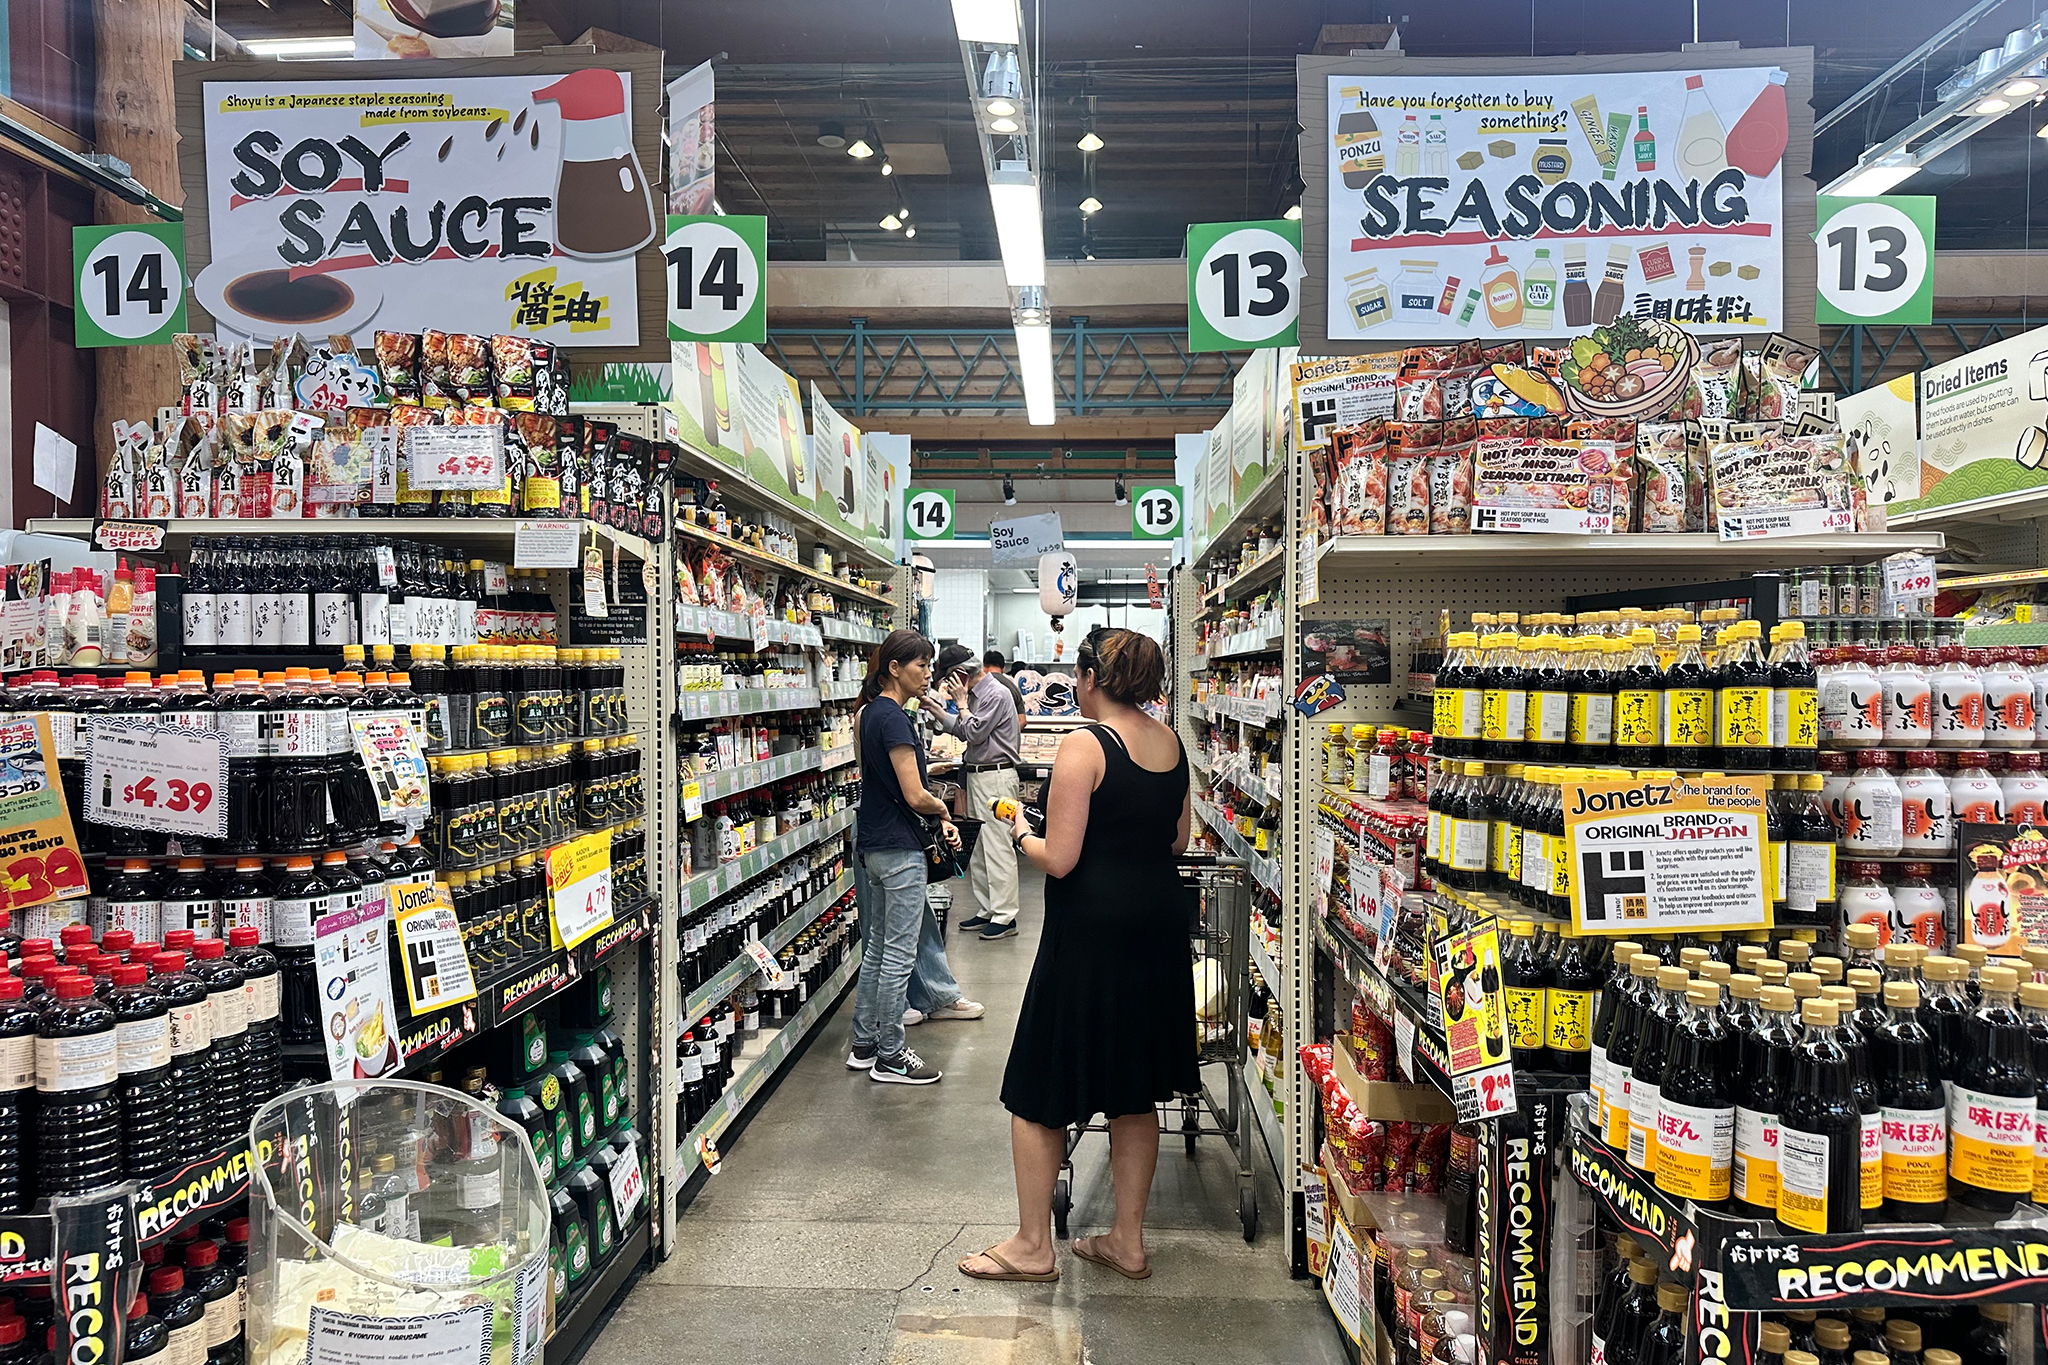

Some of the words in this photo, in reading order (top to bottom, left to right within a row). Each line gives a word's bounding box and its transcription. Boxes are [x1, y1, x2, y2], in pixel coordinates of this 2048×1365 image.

[227, 95, 261, 107] Shoyu
[265, 95, 275, 106] is
[278, 97, 286, 106] a
[289, 94, 345, 108] Japanese
[348, 93, 385, 106] staple
[388, 93, 445, 107] seasoning
[1359, 91, 1394, 108] Have
[1402, 96, 1425, 110] you
[1430, 91, 1500, 112] forgotten
[1505, 92, 1518, 107] to
[1524, 89, 1553, 109] buy
[365, 108, 397, 119] made
[400, 107, 428, 118] from
[432, 106, 491, 120] soybeans.
[1481, 110, 1568, 133] something?
[1580, 108, 1605, 145] GINGER
[1339, 140, 1382, 160] PONZU
[1638, 151, 1653, 159] sauce
[1639, 143, 1650, 152] HOT
[230, 131, 411, 198] SOY
[1538, 160, 1565, 169] MUSTARD
[1361, 169, 1750, 240] SEASONING
[277, 196, 553, 266] SAUCE
[1646, 257, 1665, 267] CURRY
[1825, 225, 1908, 293] 13
[666, 246, 743, 310] 14
[1566, 271, 1586, 279] SAUCE
[1604, 270, 1624, 280] SAUCE
[92, 252, 167, 316] 14
[1209, 250, 1289, 318] 13
[1529, 284, 1549, 293] VINE
[511, 281, 600, 325] 醤油
[1408, 299, 1428, 307] SOLT
[1492, 291, 1513, 302] honey
[1529, 292, 1549, 300] GAR
[1360, 301, 1382, 315] SUGAR
[1633, 293, 1753, 324] 調味料
[1295, 360, 1351, 382] Jonetz
[1346, 374, 1377, 384] BRAND
[1926, 370, 1961, 400] Dried
[1965, 358, 2008, 387] Items
[1303, 384, 1345, 395] ORIGINAL
[1347, 380, 1396, 392] JAPAN
[1989, 386, 2013, 402] putting
[1987, 400, 2006, 412] some
[1481, 442, 1501, 450] Ready
[1482, 449, 1508, 461] HOT
[1512, 448, 1538, 457] POT
[1541, 447, 1579, 458] SOUP
[437, 455, 493, 476] $4.99
[1487, 459, 1506, 467] made
[1521, 460, 1556, 469] MISO
[1715, 462, 1740, 479] HOT
[1744, 455, 1769, 468] POT
[1772, 450, 1809, 462] SOUP
[1480, 471, 1532, 482] SEAFOOD
[1534, 473, 1586, 483] EXTRACT
[1788, 476, 1821, 488] MILK
[912, 501, 945, 528] 14
[1141, 498, 1173, 525] 13
[1579, 517, 1609, 528] $4.39
[1823, 513, 1850, 527] $4.39
[100, 529, 153, 539] Buyers
[993, 526, 1014, 540] Soy
[109, 537, 158, 548] Select
[995, 535, 1029, 549] Sauce
[1037, 543, 1060, 554] しょうゆ
[1901, 577, 1930, 592] $4.99
[1622, 701, 1634, 743] ぽん酢
[1677, 700, 1693, 743] ぽん酢
[1729, 699, 1744, 743] ぽん酢
[287, 713, 299, 752] 昆布つゆ
[123, 775, 212, 814] $4.39
[1702, 785, 1732, 796] brand
[1735, 785, 1751, 796] for
[1571, 783, 1673, 815] Jonetz
[1707, 795, 1725, 806] the
[1727, 796, 1761, 808] people
[1663, 813, 1717, 828] BRAND
[1718, 816, 1734, 825] OF
[1585, 824, 1665, 840] ORIGINAL
[1664, 825, 1748, 841] JAPAN
[20, 836, 64, 853] TSUYU
[2003, 853, 2041, 866] Shabu
[555, 859, 574, 888] PRICE
[586, 885, 606, 915] 4.79
[366, 904, 382, 915] UDON
[406, 919, 437, 932] ORIGINAL
[437, 919, 457, 930] JAPAN
[596, 918, 637, 953] RECOMMEND
[504, 963, 559, 1004] RECOMMEND
[652, 922, 660, 1038] RECOMMEND
[1480, 1073, 1511, 1112] $2.99
[1459, 1110, 1480, 1122] PONZU
[1968, 1106, 2033, 1132] 味ぽん
[1533, 1103, 1547, 1155] おすすめ
[1882, 1121, 1944, 1142] 味ぽん
[1987, 1132, 2023, 1142] AJIPON
[1784, 1132, 1806, 1142] Nutrition
[1807, 1138, 1825, 1146] Facts
[1660, 1150, 1676, 1161] PONZU
[1990, 1148, 2016, 1157] PONZU
[1684, 1165, 1701, 1174] SAUCE
[138, 1140, 272, 1239] RECOMMEND
[1572, 1147, 1666, 1237] RECOMMEND
[1477, 1121, 1491, 1332] RECOMMEND
[105, 1203, 124, 1271] おすすめ
[1507, 1138, 1539, 1346] RECOMMEND
[1730, 1244, 1800, 1265] おすすめ
[1777, 1243, 2048, 1300] RECOMMEND
[321, 1326, 344, 1337] JONETZ
[348, 1331, 385, 1341] RYOKUTOU
[389, 1332, 428, 1341] HARUSAME
[1515, 1357, 1539, 1365] CHECK
